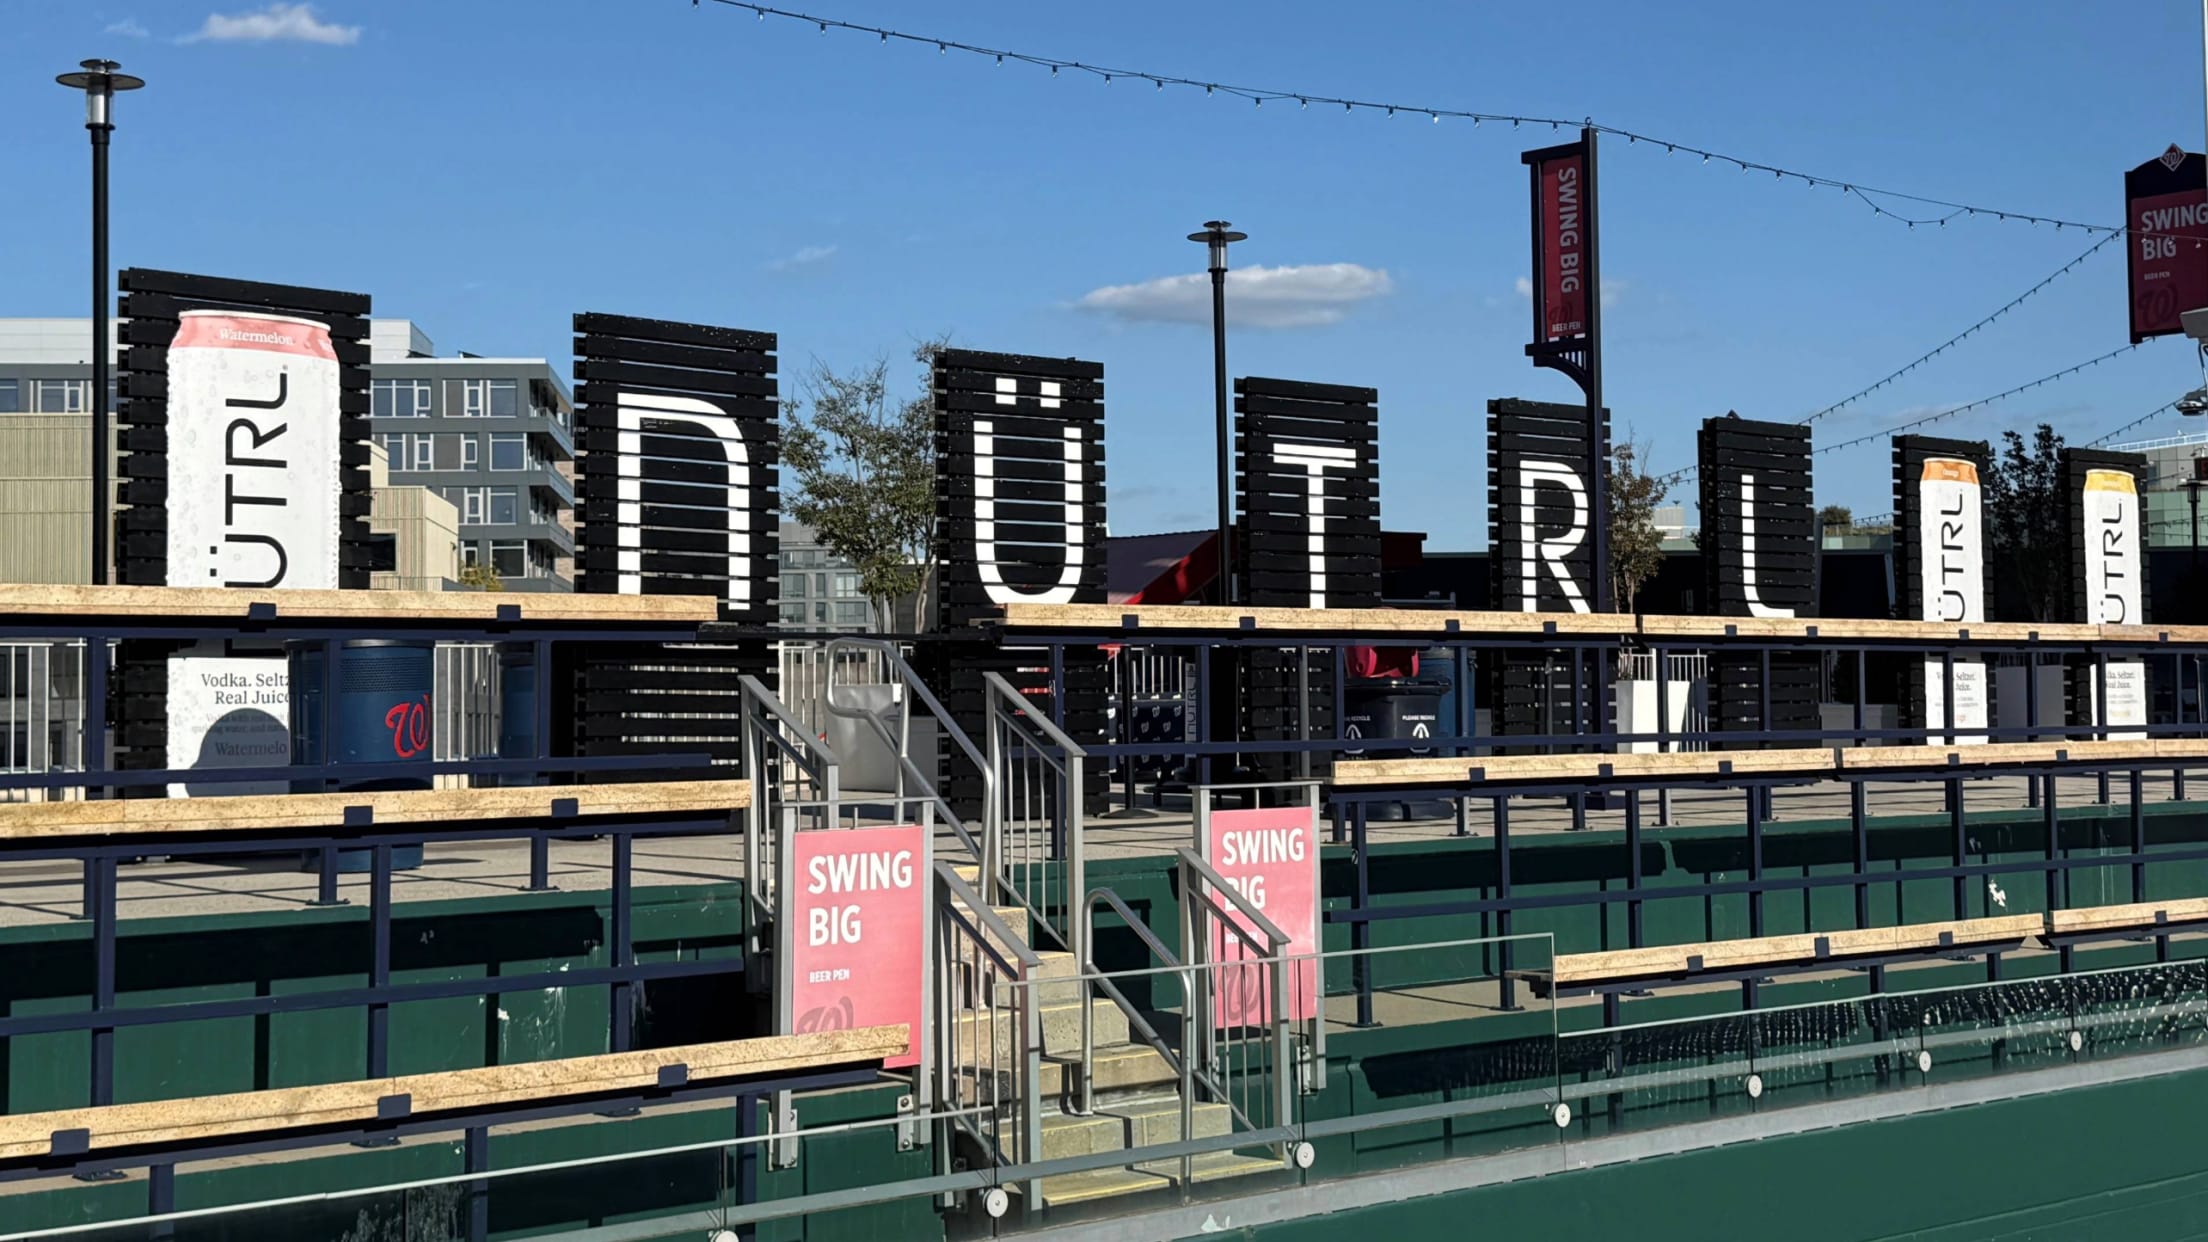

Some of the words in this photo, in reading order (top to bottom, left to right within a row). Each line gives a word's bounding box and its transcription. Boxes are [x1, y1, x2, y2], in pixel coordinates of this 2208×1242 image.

[1558, 167, 1579, 247] SWING
[2141, 203, 2208, 232] SWING
[2143, 236, 2176, 260] BIG
[1560, 253, 1579, 293] BIG
[219, 329, 294, 346] Watermelon
[1552, 323, 1567, 332] BEER
[1569, 321, 1580, 330] PEN
[210, 372, 288, 588] ÜTRL
[1937, 494, 1966, 622] ÜTRL
[2100, 503, 2126, 624] ÜTRL
[201, 673, 252, 688] Vodka.
[214, 690, 248, 704] Real
[215, 740, 288, 756] Watermelo
[1221, 828, 1305, 866] SWING
[807, 851, 913, 894] SWING
[808, 905, 862, 946] BIG
[809, 970, 831, 983] BEER
[833, 968, 850, 981] PEN
